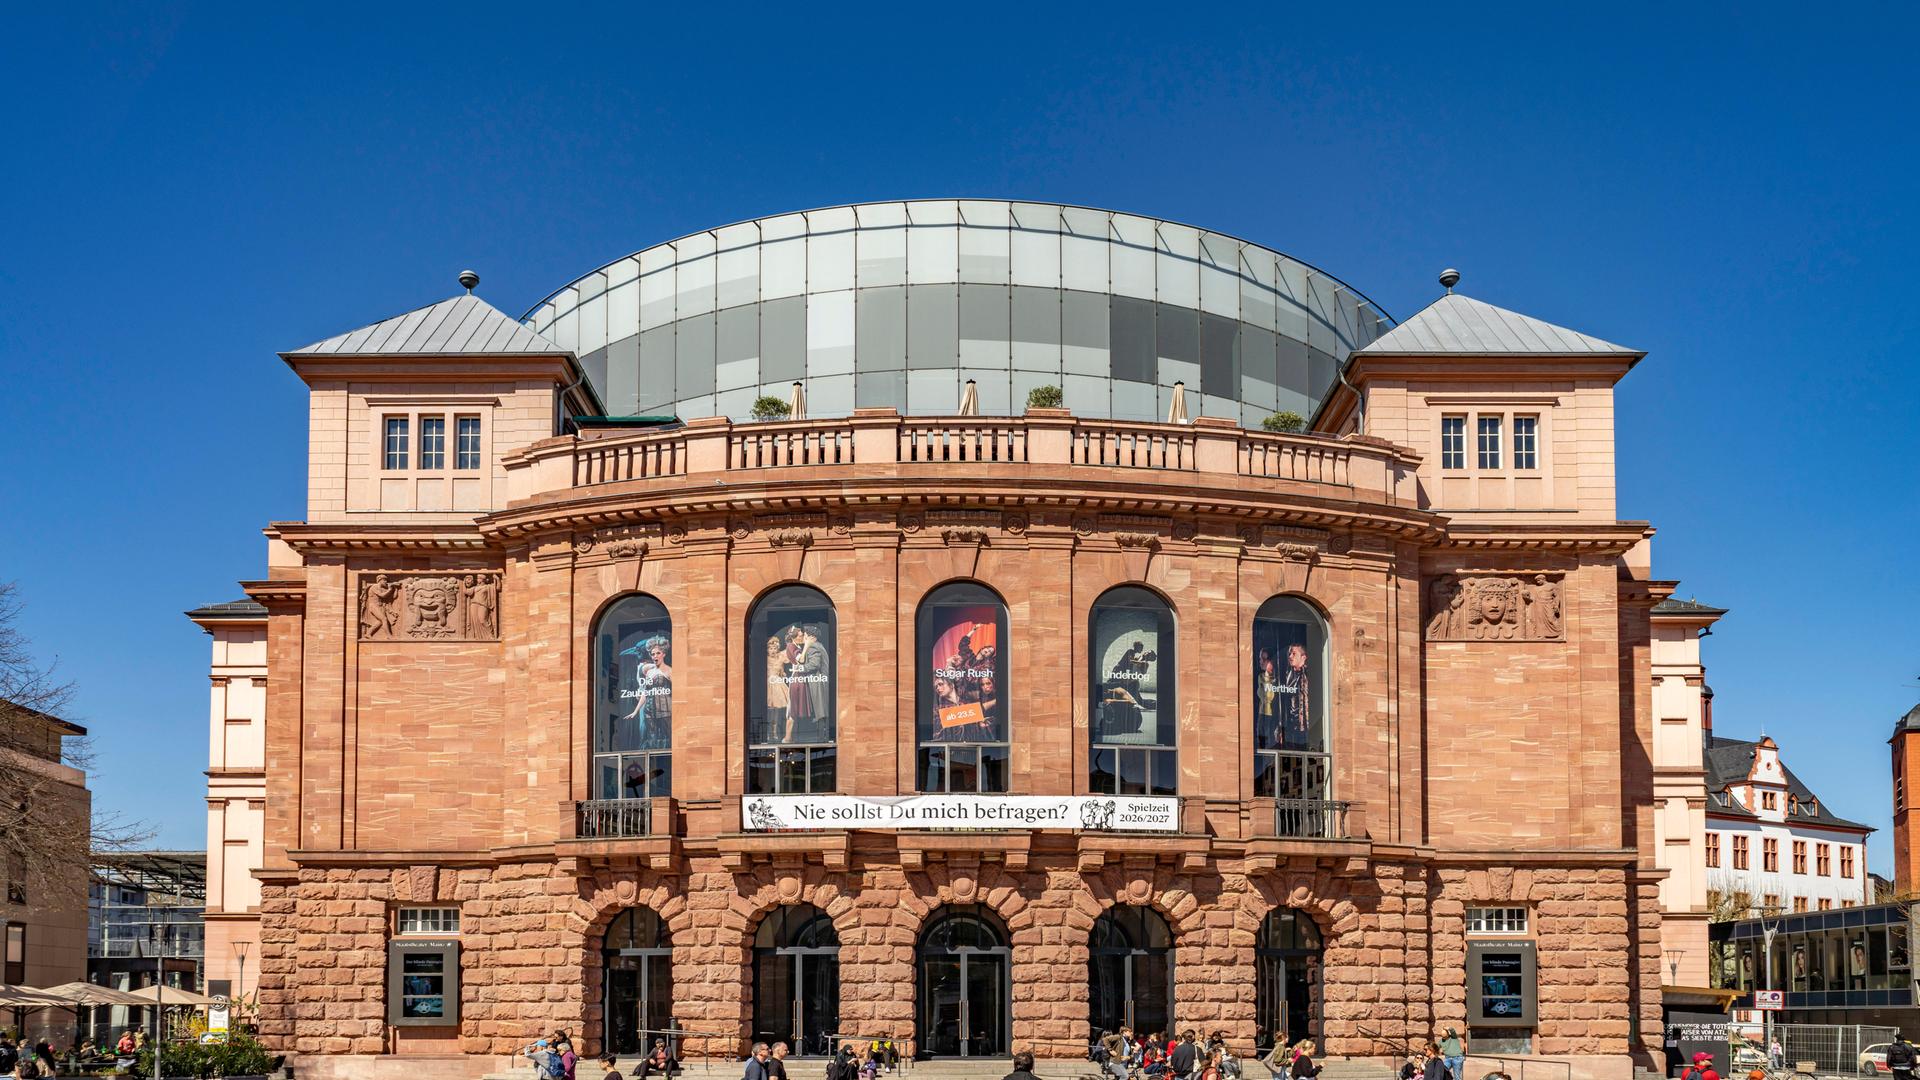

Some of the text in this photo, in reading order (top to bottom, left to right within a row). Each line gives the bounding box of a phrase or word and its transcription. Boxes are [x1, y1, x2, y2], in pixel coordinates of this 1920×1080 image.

[791, 664, 804, 672] La
[769, 673, 828, 684] Cenerentola
[935, 668, 993, 679] Sugar Rush
[1103, 670, 1150, 681] Underdog
[639, 677, 654, 686] Die
[620, 687, 671, 698] Zauberflöte
[1264, 683, 1298, 693] Werther
[946, 713, 956, 721] ab
[794, 803, 1069, 823] Nie sollst Du mich befragen?
[1128, 803, 1169, 813] Spielzeit
[1120, 814, 1170, 823] 2026/2027
